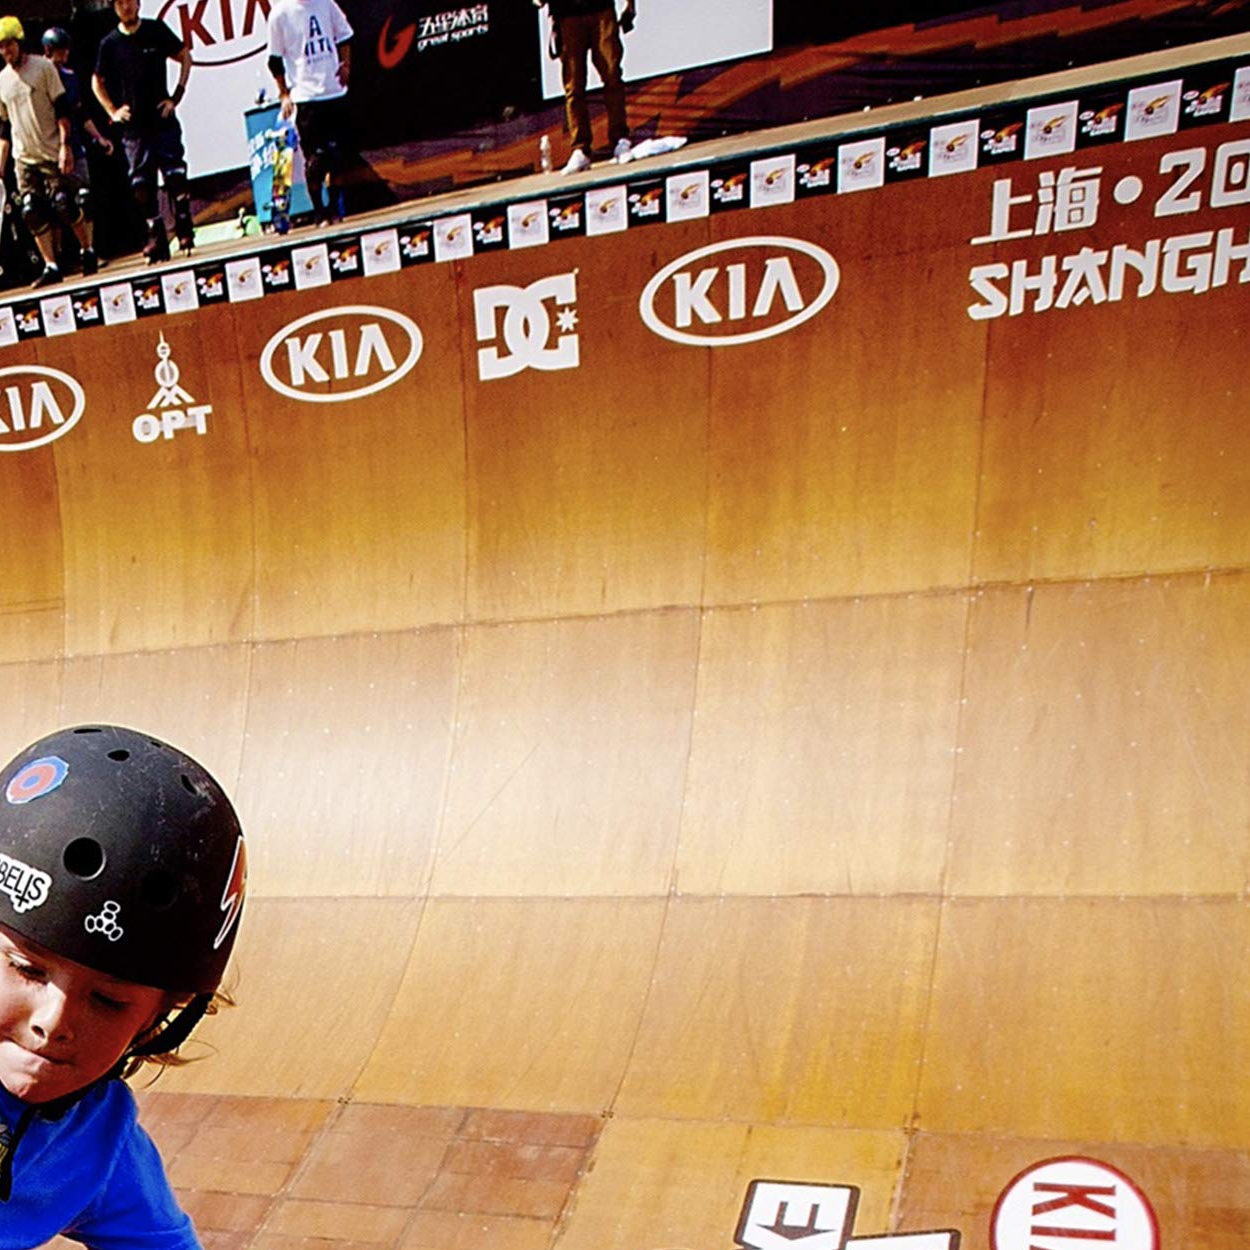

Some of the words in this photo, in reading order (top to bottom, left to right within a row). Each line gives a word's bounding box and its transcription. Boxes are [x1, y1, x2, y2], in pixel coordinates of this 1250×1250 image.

[474, 271, 579, 381] DC
[672, 257, 807, 328] KIA
[284, 323, 397, 386] KIA
[132, 405, 213, 443] OPT
